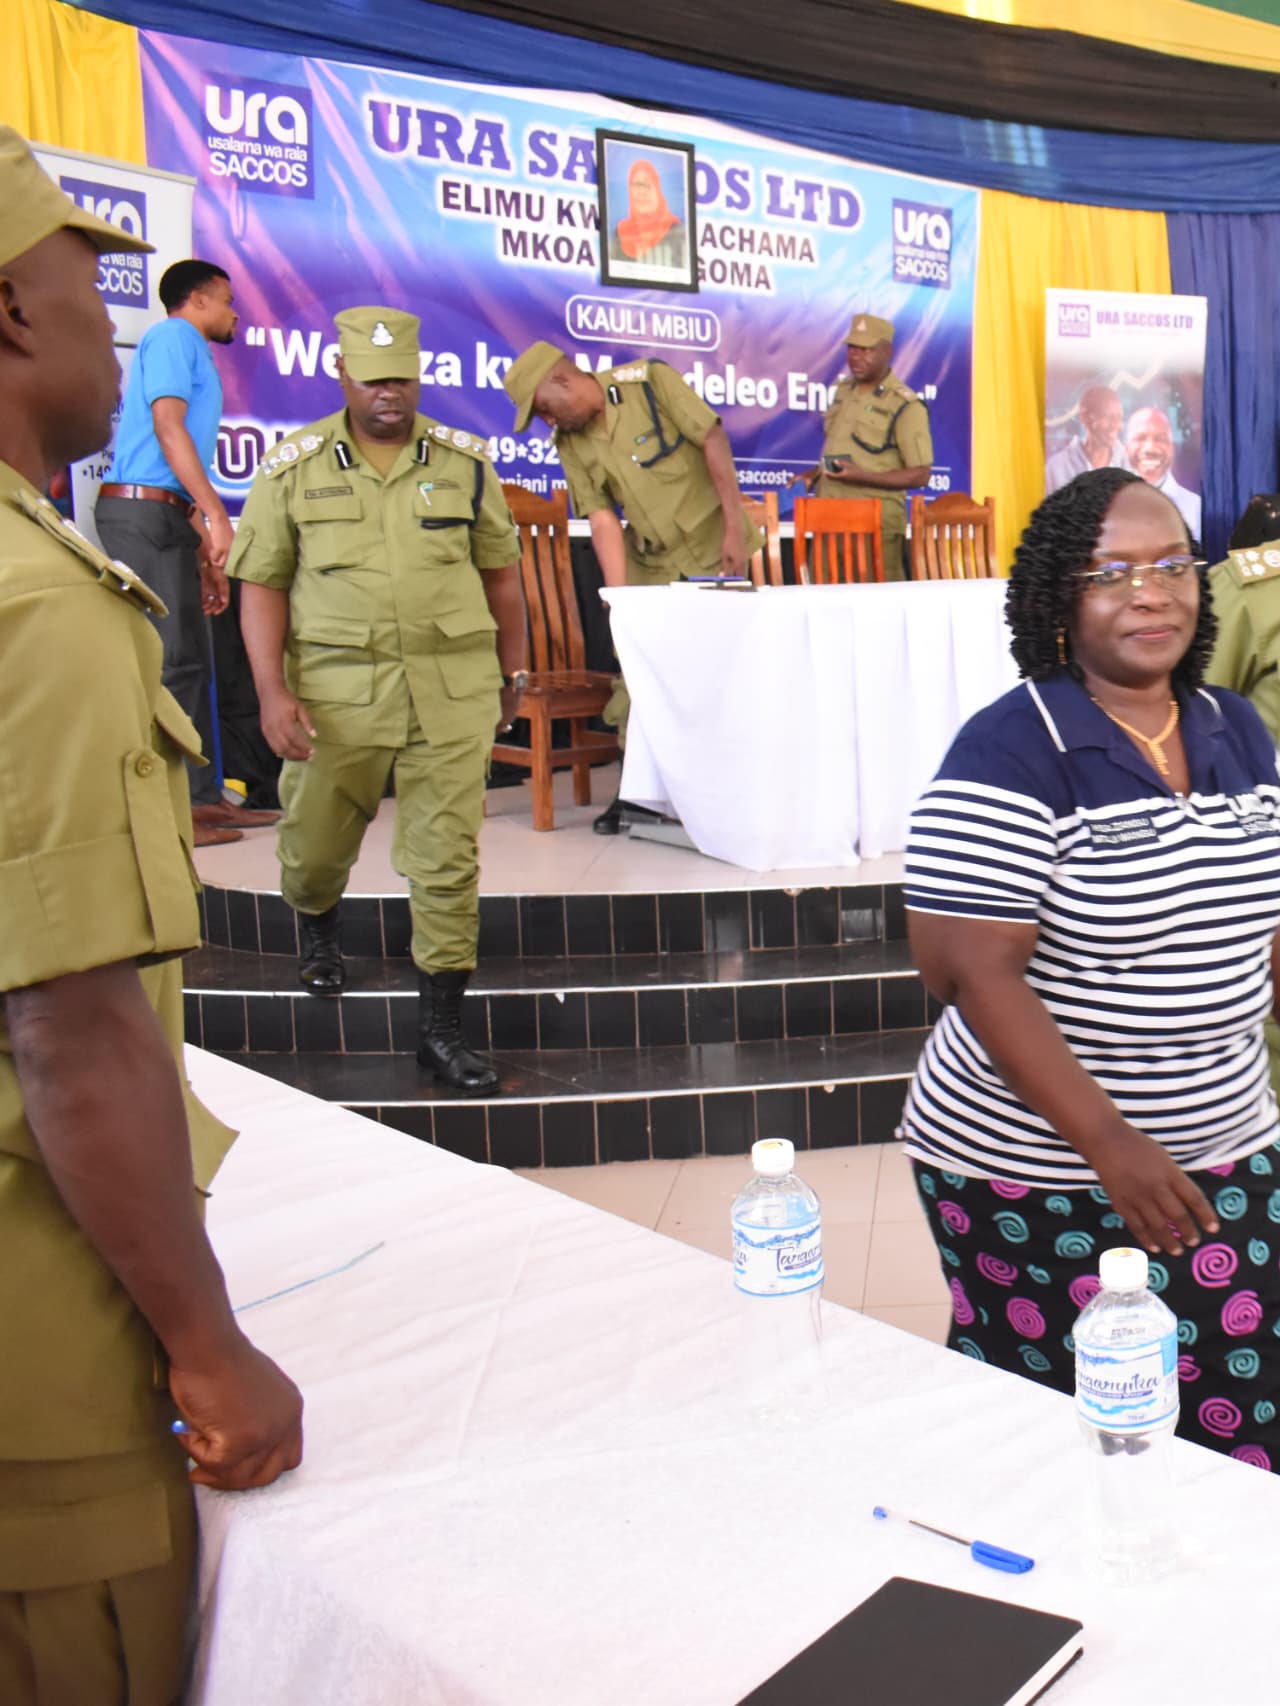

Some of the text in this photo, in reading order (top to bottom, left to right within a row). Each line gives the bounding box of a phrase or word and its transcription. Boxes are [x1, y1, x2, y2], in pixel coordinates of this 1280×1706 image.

[205, 84, 309, 146] ura
[207, 136, 308, 162] usalama wa raia
[369, 99, 511, 171] URA
[766, 174, 861, 228] LTD
[208, 151, 309, 187] SACCOS
[442, 180, 815, 263] ELIMU KW ACHAMA
[894, 207, 951, 251] ura
[502, 228, 596, 267] MKOA
[94, 266, 144, 296] CCOS
[895, 256, 949, 283] SACCOS
[577, 304, 712, 342] KAULI MBIU
[1096, 310, 1194, 329] URA SACCOS LTD
